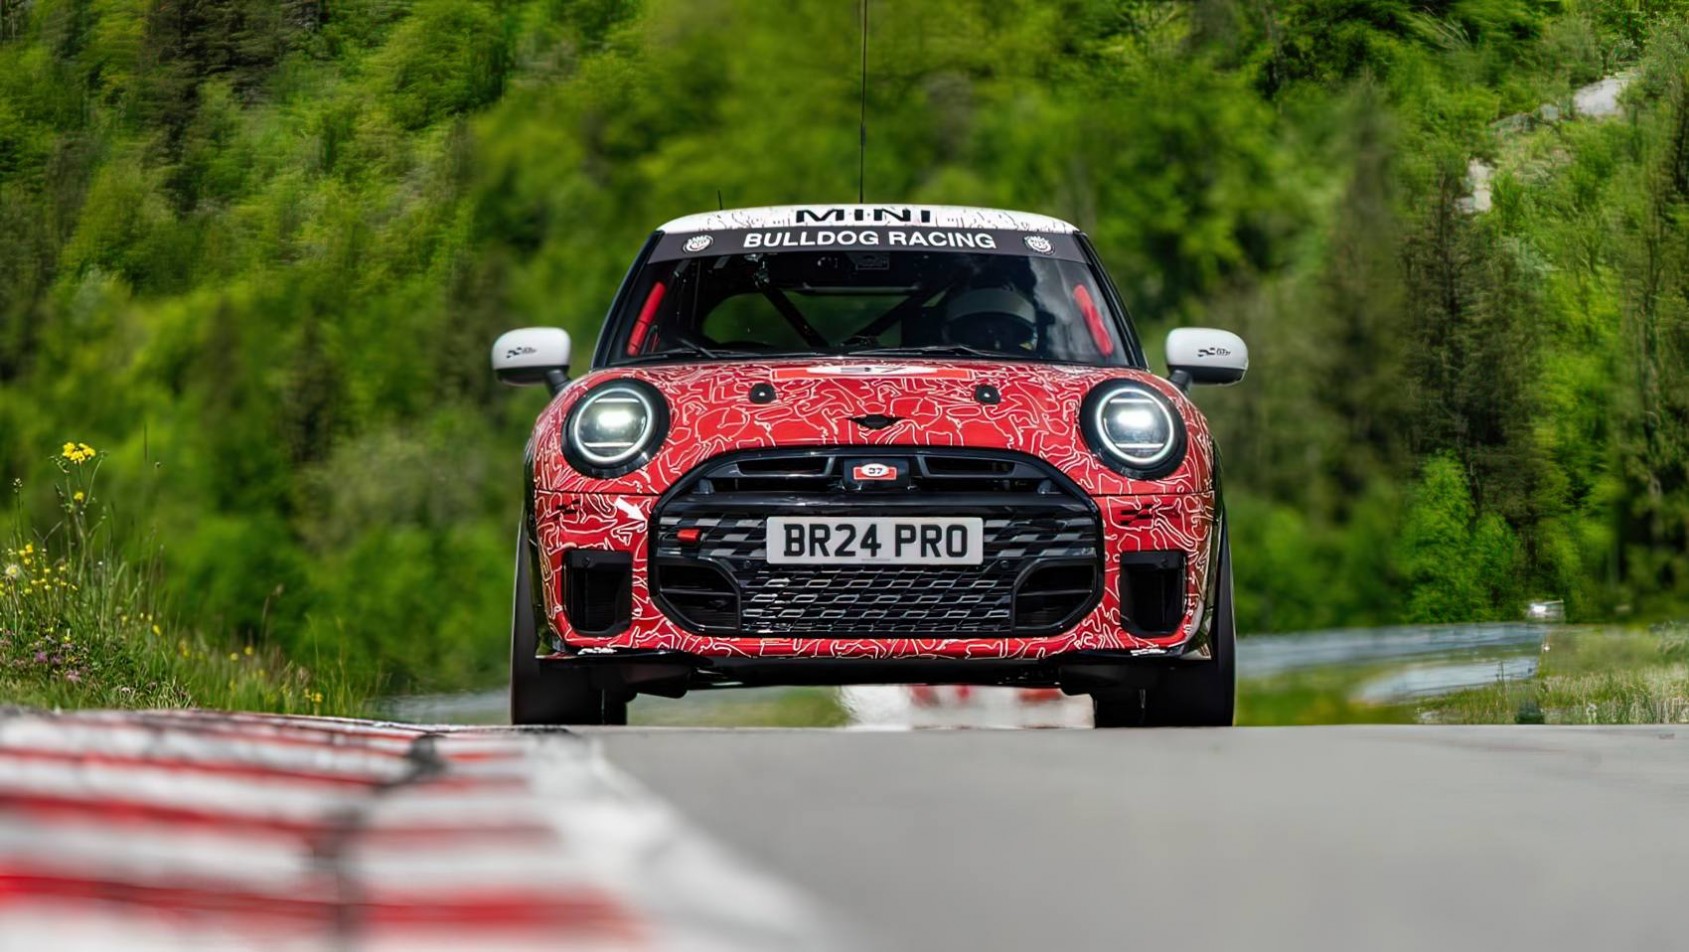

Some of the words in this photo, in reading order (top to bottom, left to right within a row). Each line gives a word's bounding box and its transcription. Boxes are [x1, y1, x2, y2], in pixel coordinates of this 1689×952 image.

[796, 209, 931, 223] MINI
[743, 231, 879, 248] BULLDOG
[888, 231, 996, 249] RACING
[868, 467, 883, 475] 37
[783, 523, 882, 558] BR24
[895, 523, 968, 558] PRO
